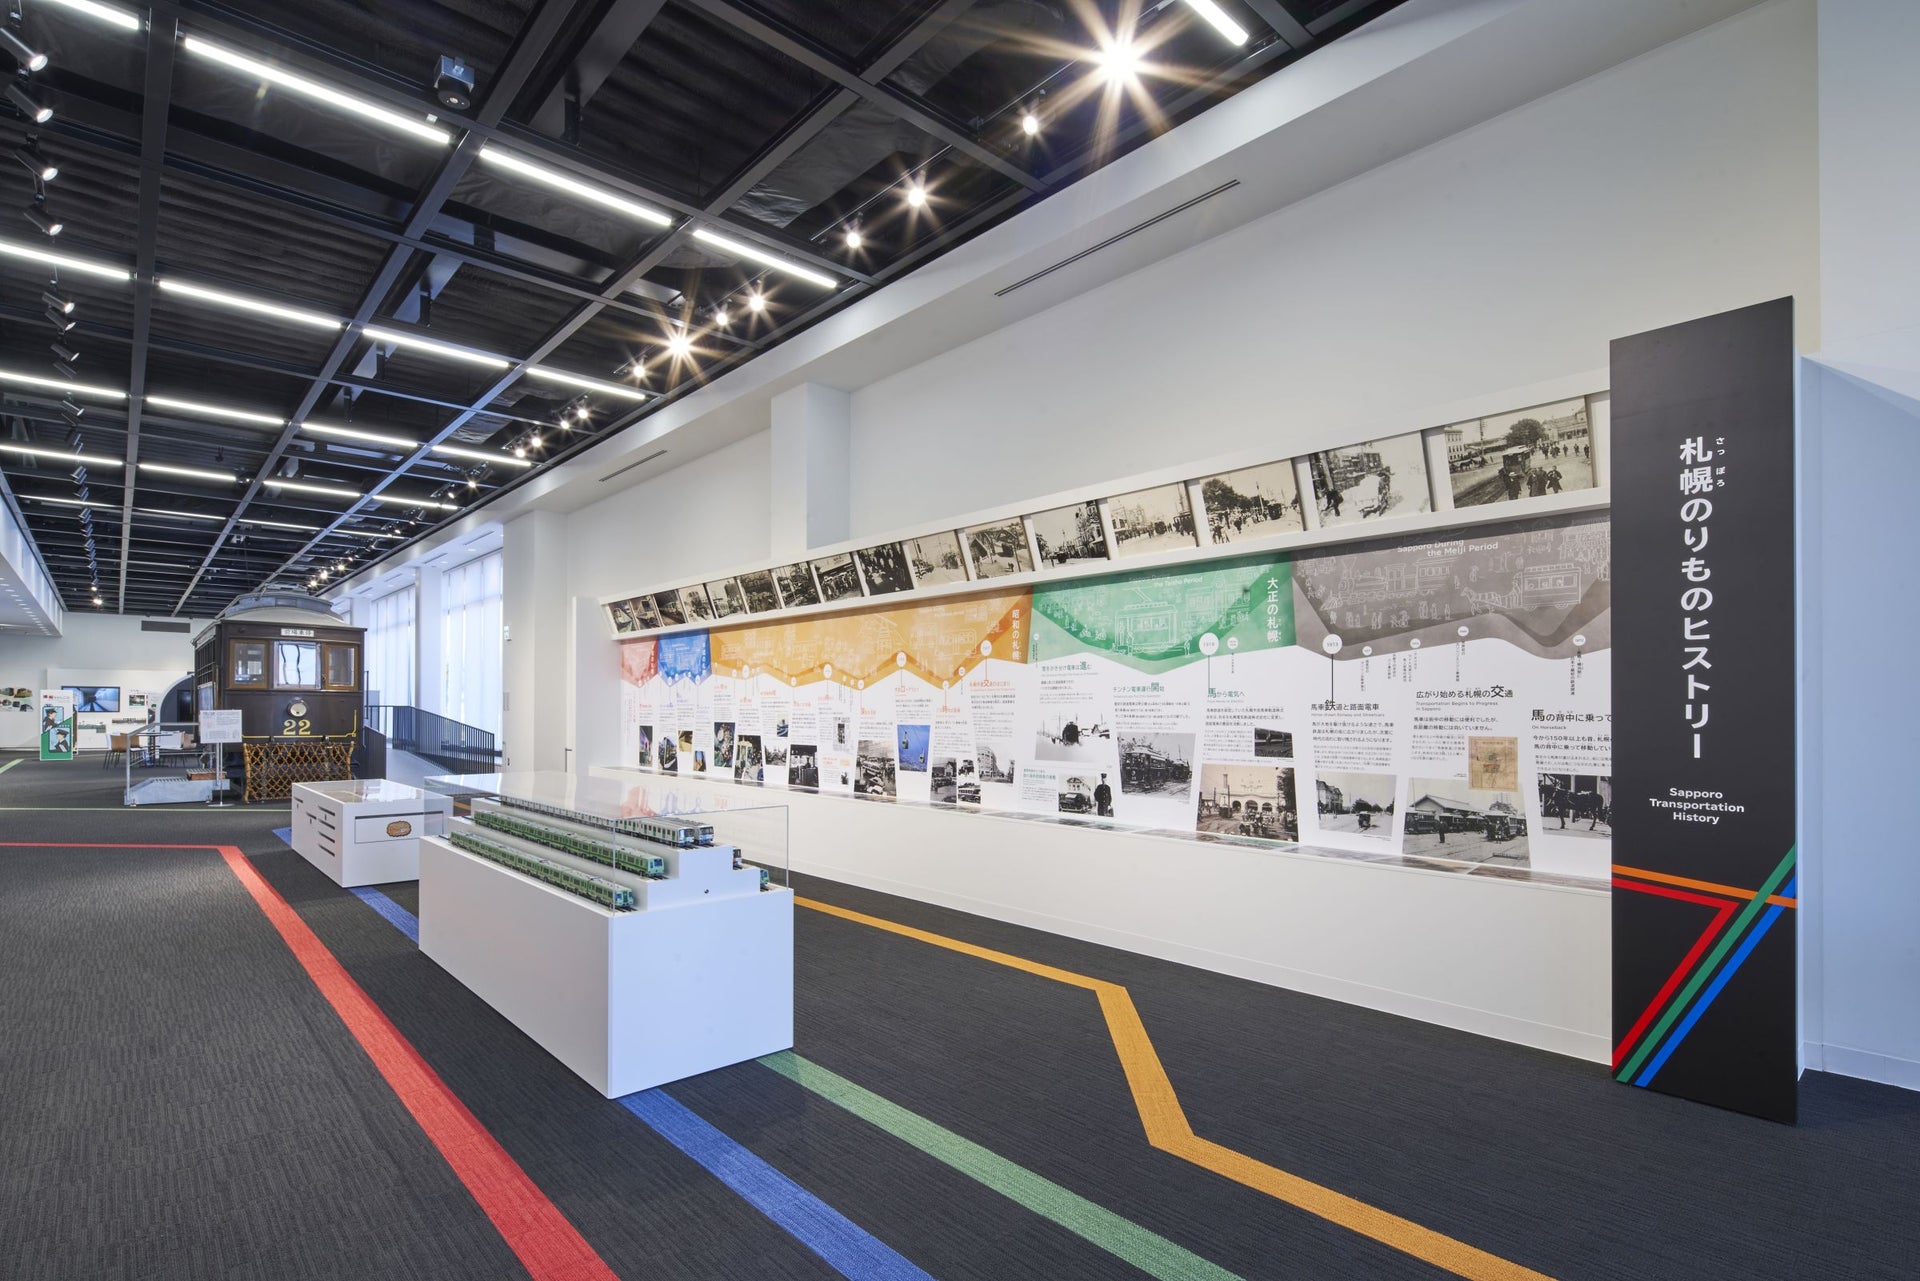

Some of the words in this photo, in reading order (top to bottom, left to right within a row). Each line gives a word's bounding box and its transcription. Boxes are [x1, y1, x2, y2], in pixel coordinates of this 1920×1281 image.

[1468, 541, 1499, 552] Period
[1679, 436, 1714, 759] 札幌のりものヒストリー
[283, 719, 311, 736] 22
